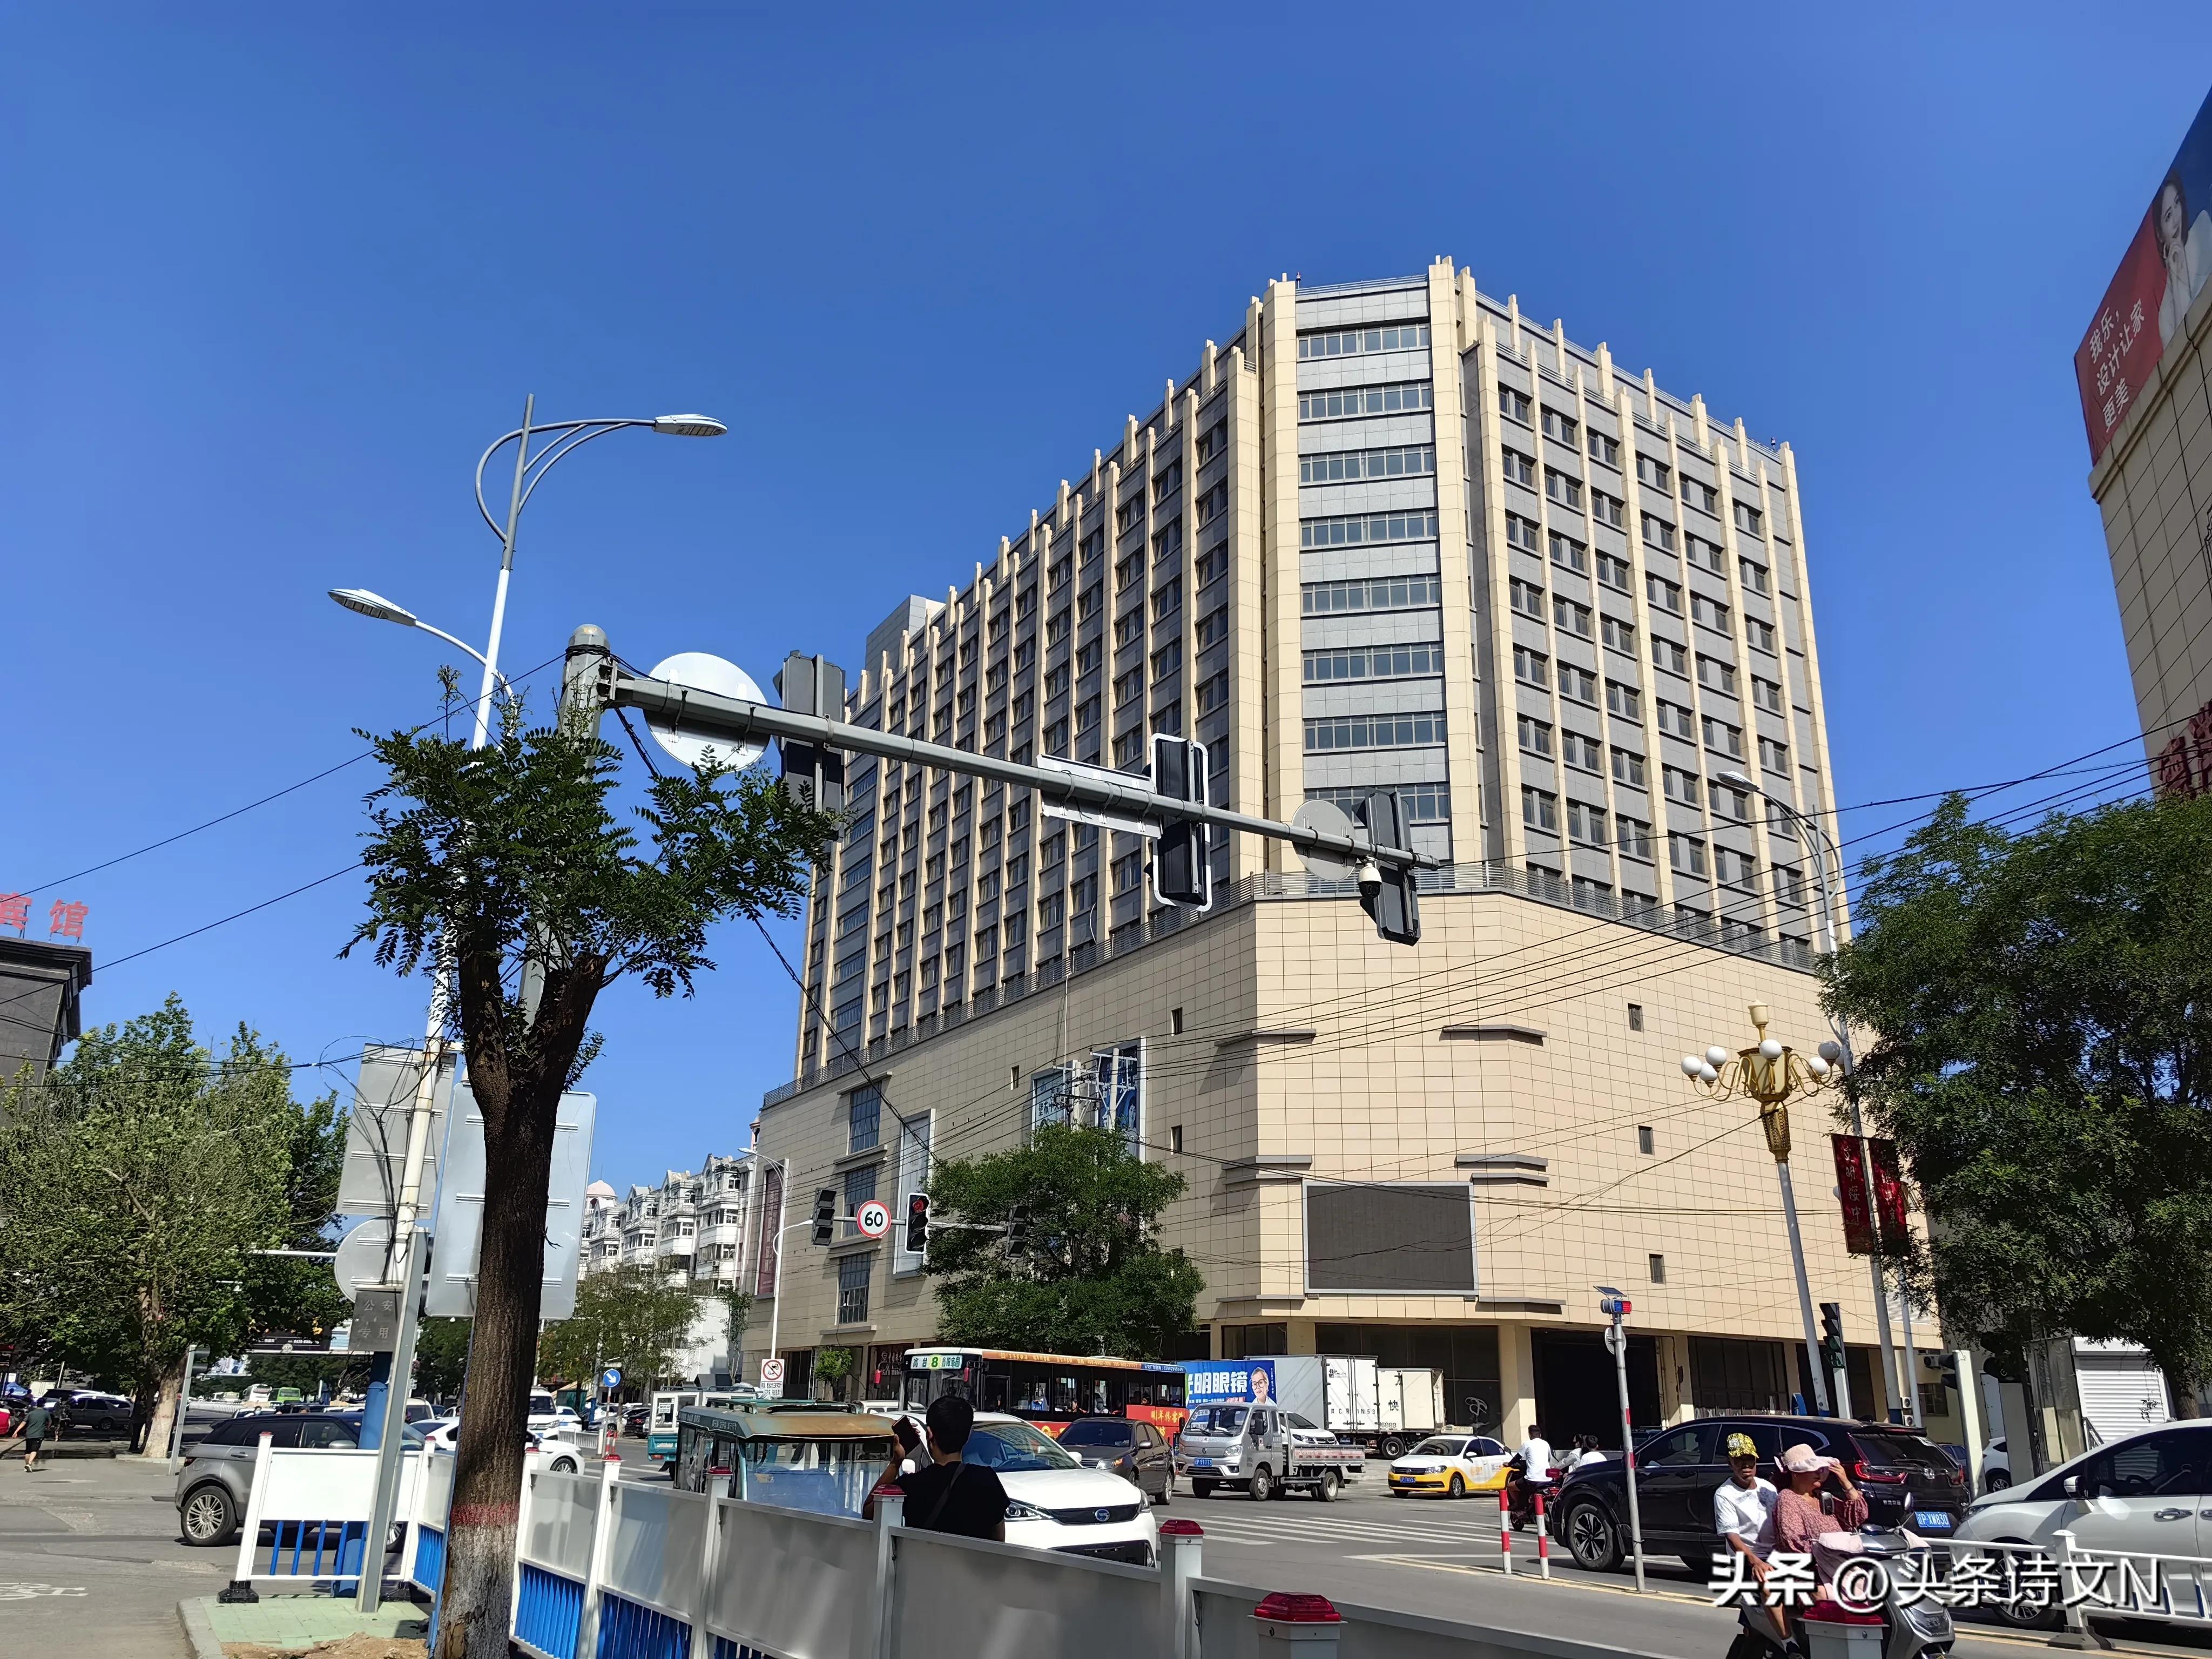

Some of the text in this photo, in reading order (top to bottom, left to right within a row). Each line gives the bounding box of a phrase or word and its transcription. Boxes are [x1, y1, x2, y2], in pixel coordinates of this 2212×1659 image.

[2090, 307, 2119, 364] 我乐，
[2097, 298, 2144, 396] 设计让家
[2102, 378, 2129, 433] 更美
[865, 1211, 883, 1227] 60
[363, 1299, 393, 1311] 公安
[358, 1326, 388, 1339] 专用
[931, 1356, 939, 1367] 8
